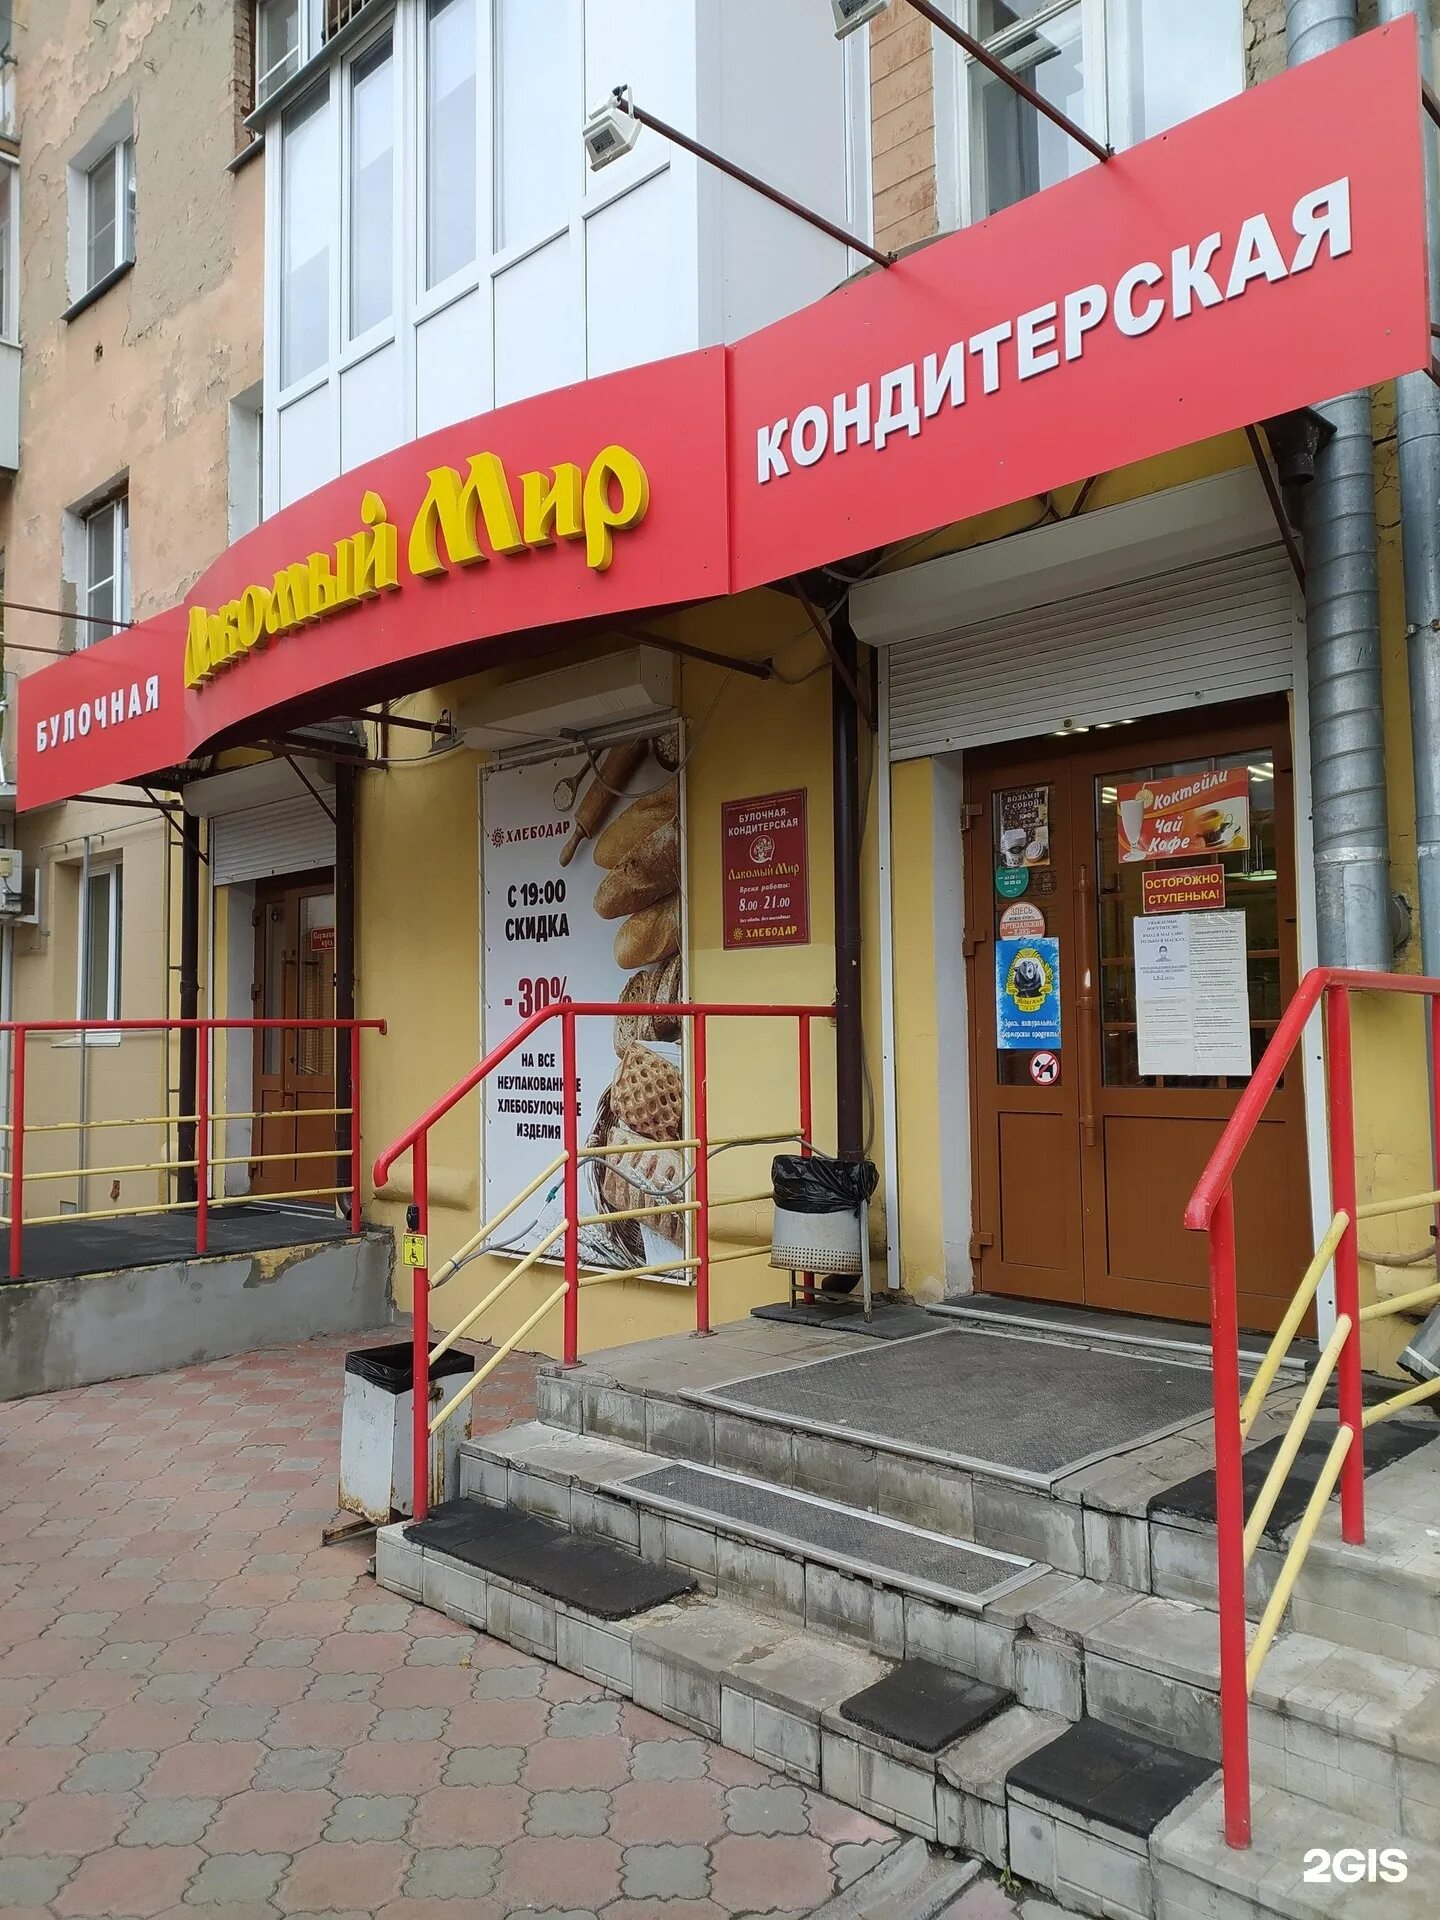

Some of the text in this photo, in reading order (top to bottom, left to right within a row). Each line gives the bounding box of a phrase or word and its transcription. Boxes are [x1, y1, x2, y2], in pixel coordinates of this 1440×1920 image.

[757, 176, 1352, 484] КОНДИТЕРСКАЯ
[408, 444, 650, 572] Мир
[36, 674, 159, 752] БУЛОЧНАЯ
[1153, 770, 1228, 810] Коктейли
[739, 807, 789, 823] БУЛОЧНАЯ-
[506, 821, 570, 843] ХЛЕБОДАР
[728, 817, 798, 837] КОНДИТЕРСКАЯ
[1155, 815, 1183, 834] Чай
[1148, 836, 1191, 854] Кофе
[728, 862, 800, 880] Лакомый Мир
[1145, 873, 1222, 890] ОСТОРОЖНО,
[507, 879, 566, 908] С 19:00
[1148, 889, 1220, 905] СТУПЕНЬКА!
[739, 898, 758, 912] 8.00
[763, 895, 791, 909] 21.00
[1010, 906, 1033, 916] ЗДЕСЬ
[505, 913, 570, 942] СКИДКА
[746, 925, 798, 938] ХЛЕБОДАР
[521, 1053, 555, 1067] НА ВСЕ
[497, 1076, 582, 1092] НЕУПАКОВАННЕ
[497, 1099, 582, 1117] ХЛЕБОБУЛОЧНЕ
[516, 1123, 561, 1140] ИЗДЕЛИЯ
